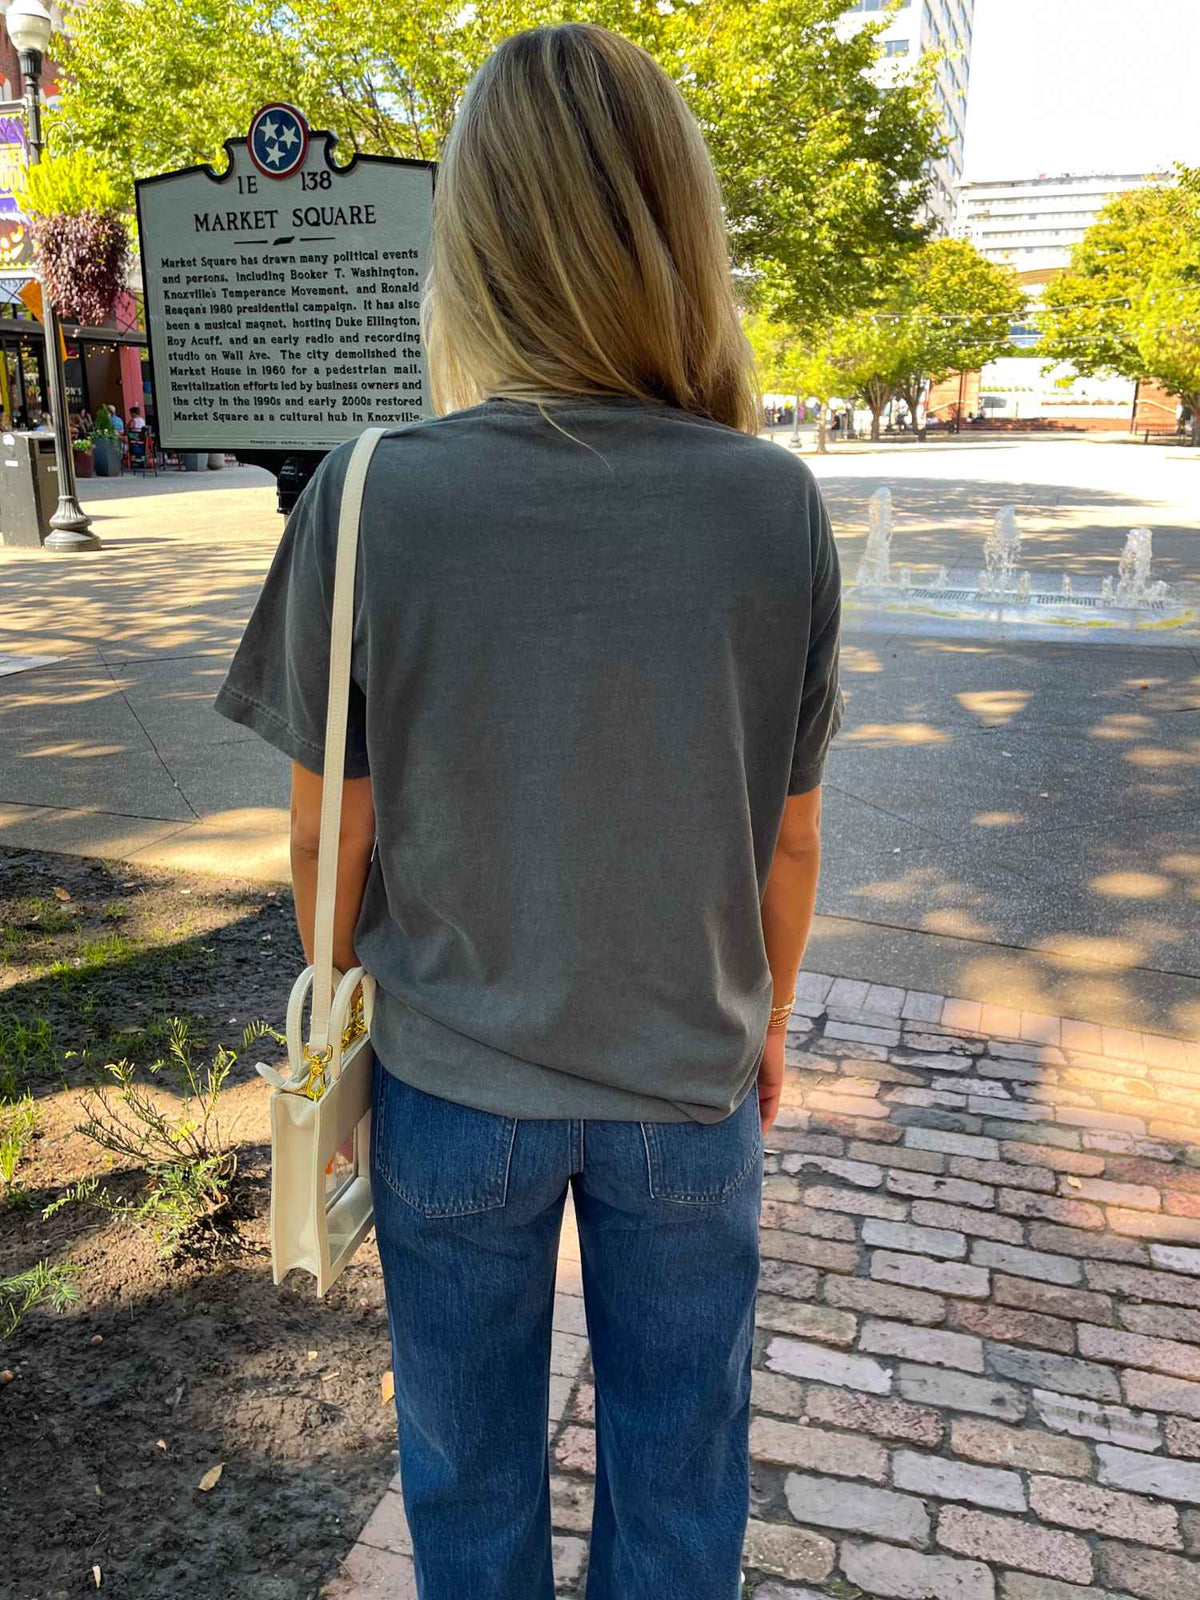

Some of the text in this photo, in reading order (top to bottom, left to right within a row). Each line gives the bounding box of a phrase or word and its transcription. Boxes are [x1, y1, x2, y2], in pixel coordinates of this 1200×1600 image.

[301, 171, 332, 191] 138
[194, 205, 376, 232] MARKET SQUARE
[161, 249, 418, 268] Market Square has drawn many political events
[162, 274, 180, 284] and
[236, 272, 285, 282] including
[290, 270, 328, 280] Booker
[222, 287, 286, 299] Temperance
[356, 284, 376, 294] and
[381, 282, 419, 293] Ronald
[210, 304, 233, 314] 1980
[236, 302, 299, 314] presidential
[363, 300, 373, 310] It
[376, 300, 394, 309] has
[399, 299, 420, 309] also
[166, 320, 190, 330] been
[194, 322, 200, 330] a
[204, 319, 241, 329] musical
[292, 318, 331, 329] hosting
[335, 317, 362, 327] Duke
[167, 336, 186, 346] Roy
[229, 335, 248, 345] and
[253, 336, 266, 344] an
[271, 334, 299, 345] early
[305, 333, 334, 343] radio
[339, 333, 359, 343] and
[365, 333, 421, 344] recording
[168, 351, 200, 361] studio
[222, 350, 243, 360] Wall
[280, 349, 301, 360] The
[307, 349, 329, 360] city
[335, 348, 397, 359] demolished
[402, 348, 421, 358] the
[170, 366, 205, 376] Market
[211, 366, 241, 375] House
[246, 365, 257, 375] in
[262, 365, 286, 375] 1960
[291, 365, 308, 375] for
[326, 364, 387, 376] pedestrian
[171, 380, 422, 392] Revitalization efforts led by business owners and
[173, 395, 423, 407] the city in the 1990s and early 2000s restored
[173, 412, 208, 421] Market
[213, 412, 248, 423] Square
[254, 413, 265, 421] as
[269, 413, 274, 421] a
[280, 412, 323, 422] cultural
[327, 412, 347, 422] hub
[353, 412, 363, 422] in
